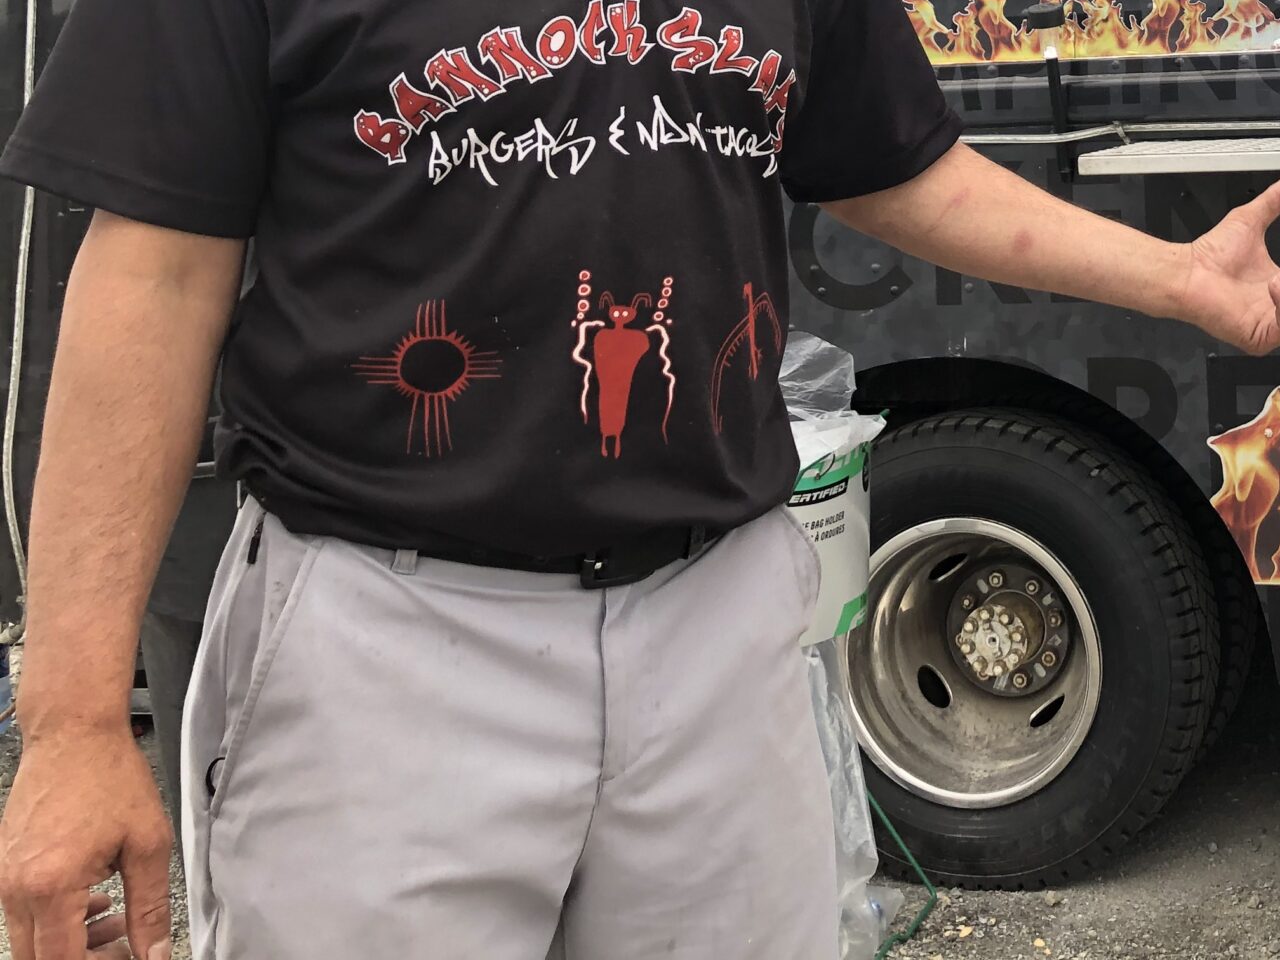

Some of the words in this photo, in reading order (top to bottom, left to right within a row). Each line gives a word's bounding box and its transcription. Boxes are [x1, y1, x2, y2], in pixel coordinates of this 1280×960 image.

[428, 118, 595, 186] BURGERS
[811, 519, 825, 530] BAG
[825, 510, 845, 527] HOLDER
